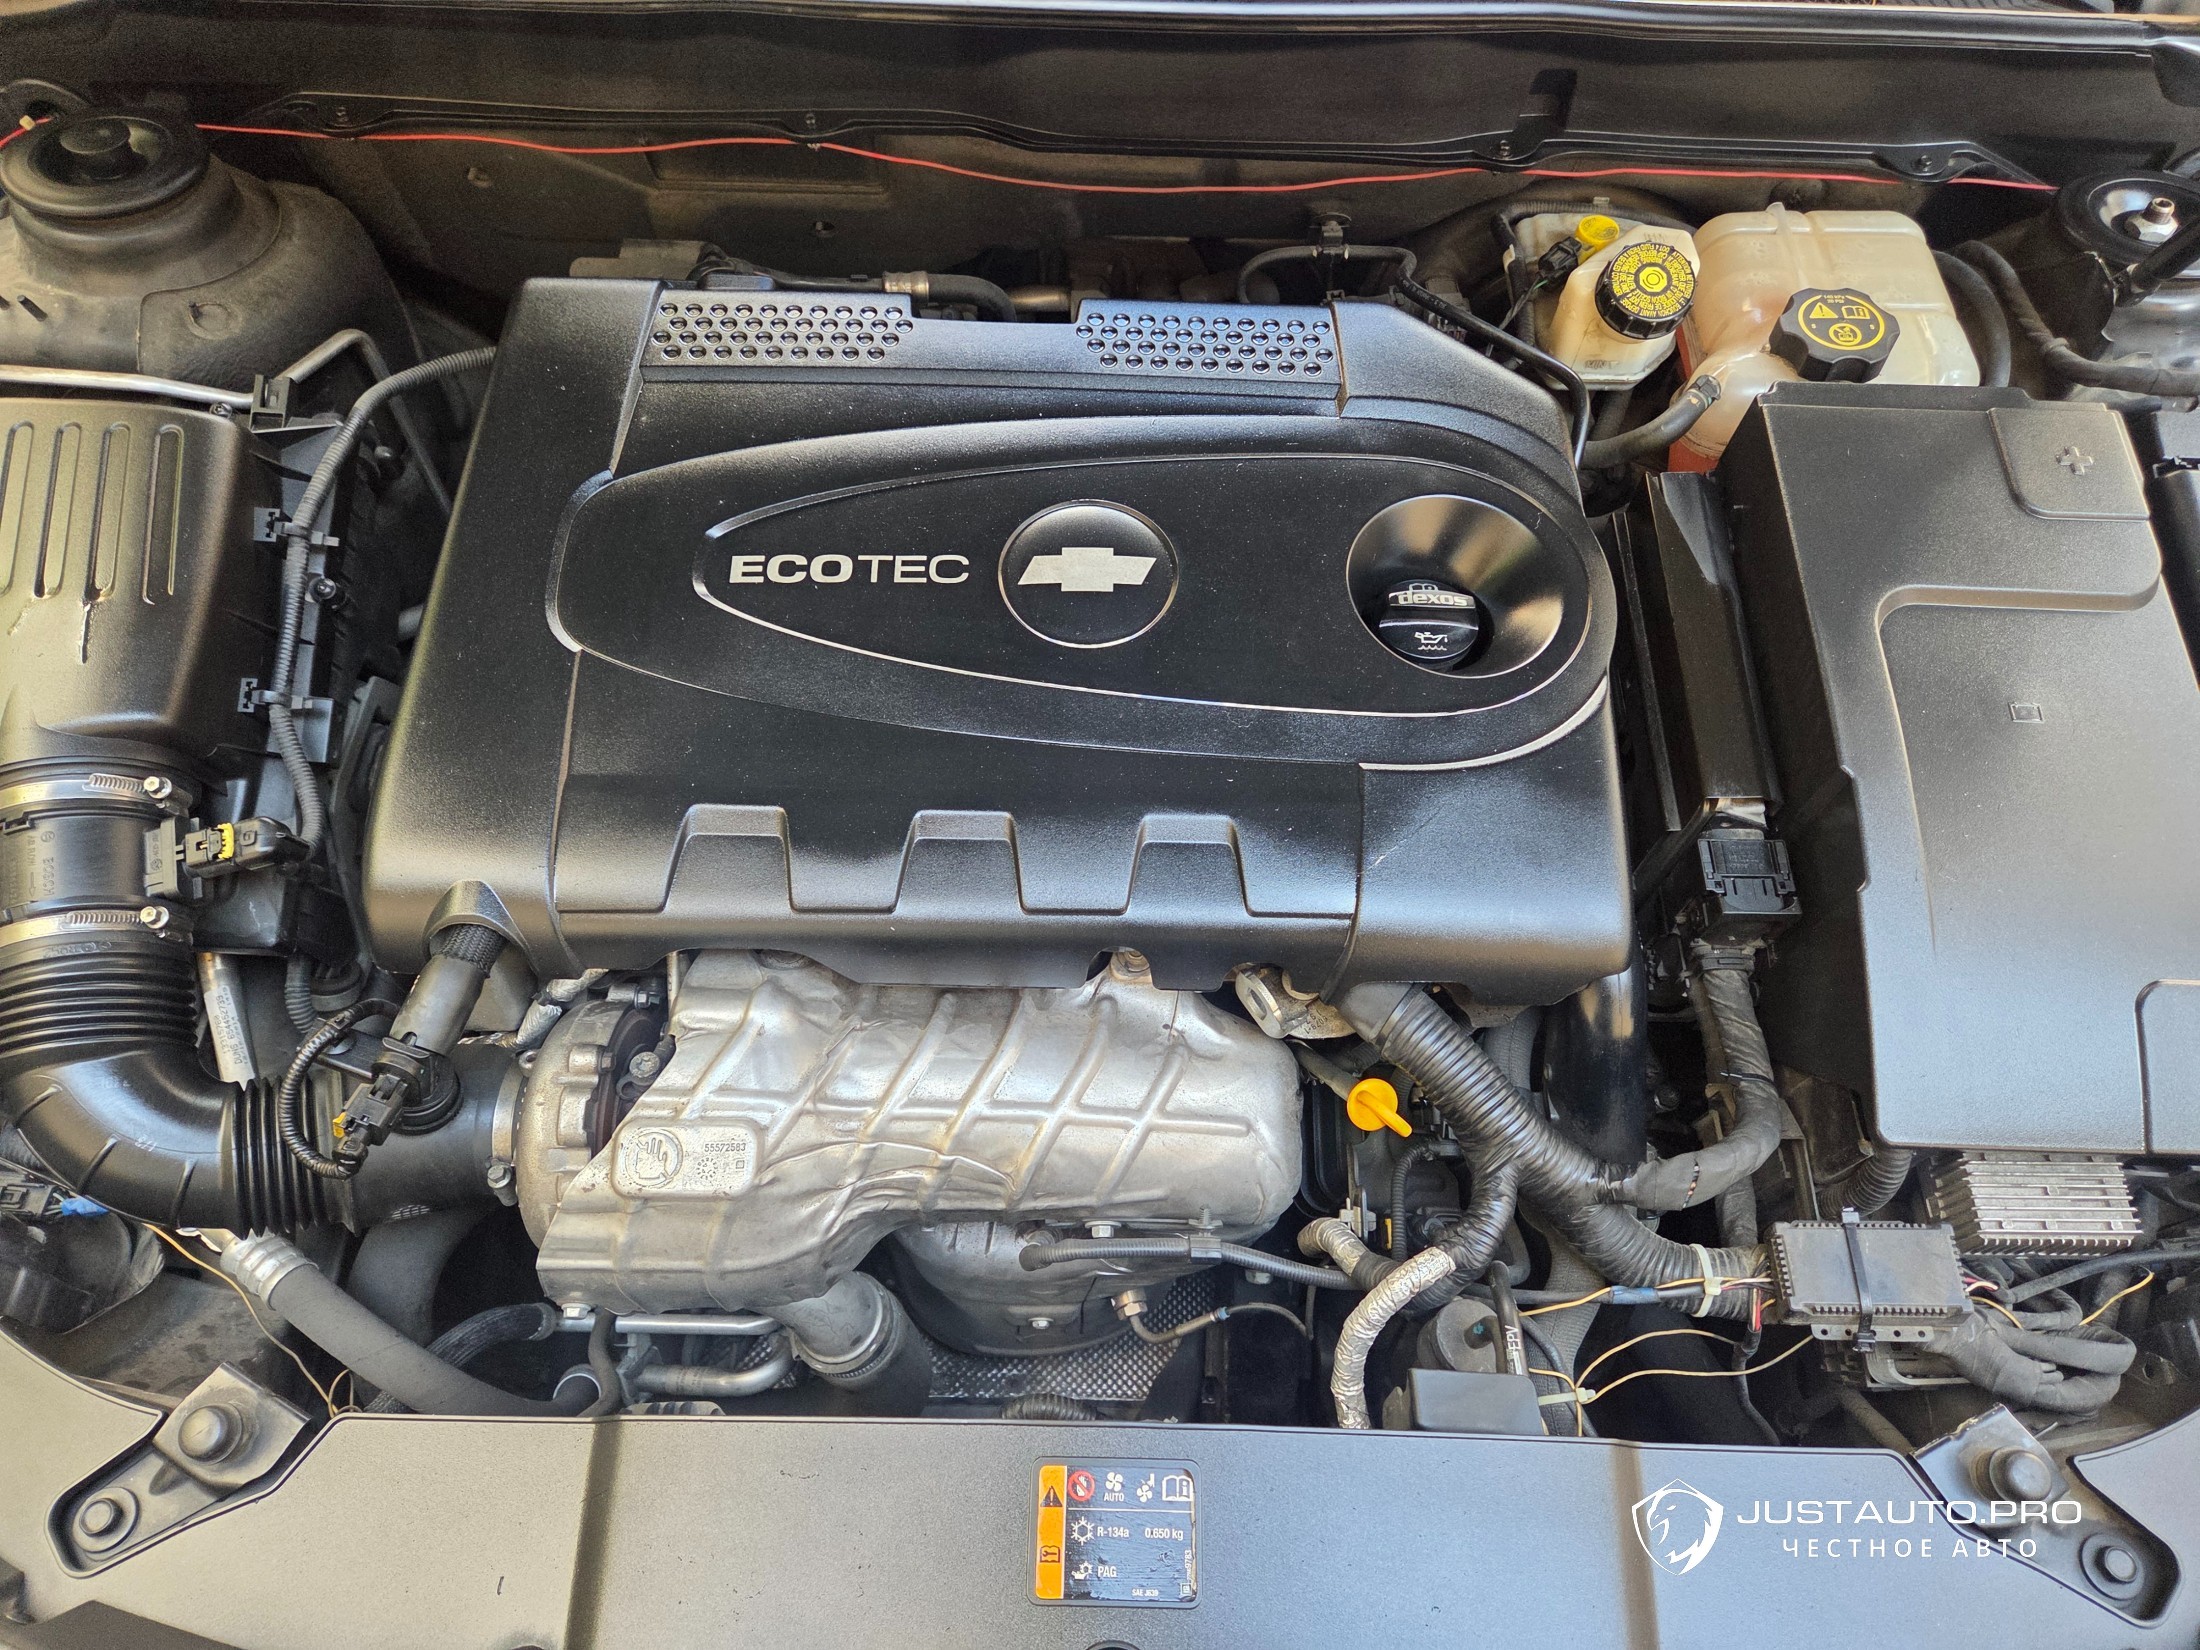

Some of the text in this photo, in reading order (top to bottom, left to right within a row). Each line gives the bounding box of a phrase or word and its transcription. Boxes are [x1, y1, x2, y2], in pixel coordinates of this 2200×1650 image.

[1627, 246, 1641, 256] FROM
[1613, 255, 1627, 271] SEALED
[1672, 251, 1692, 274] ATTENTION
[1629, 296, 1640, 305] DOT
[1638, 301, 1654, 309] FREIN
[728, 554, 970, 584] ECOTEC
[1398, 590, 1468, 606] dexos
[230, 1044, 242, 1064] DUNS
[704, 1143, 746, 1152] 55572583
[1104, 1492, 1124, 1502] AUTO
[1097, 1526, 1184, 1541] R-134a 0.650 kg
[1098, 1566, 1117, 1577] PAG
